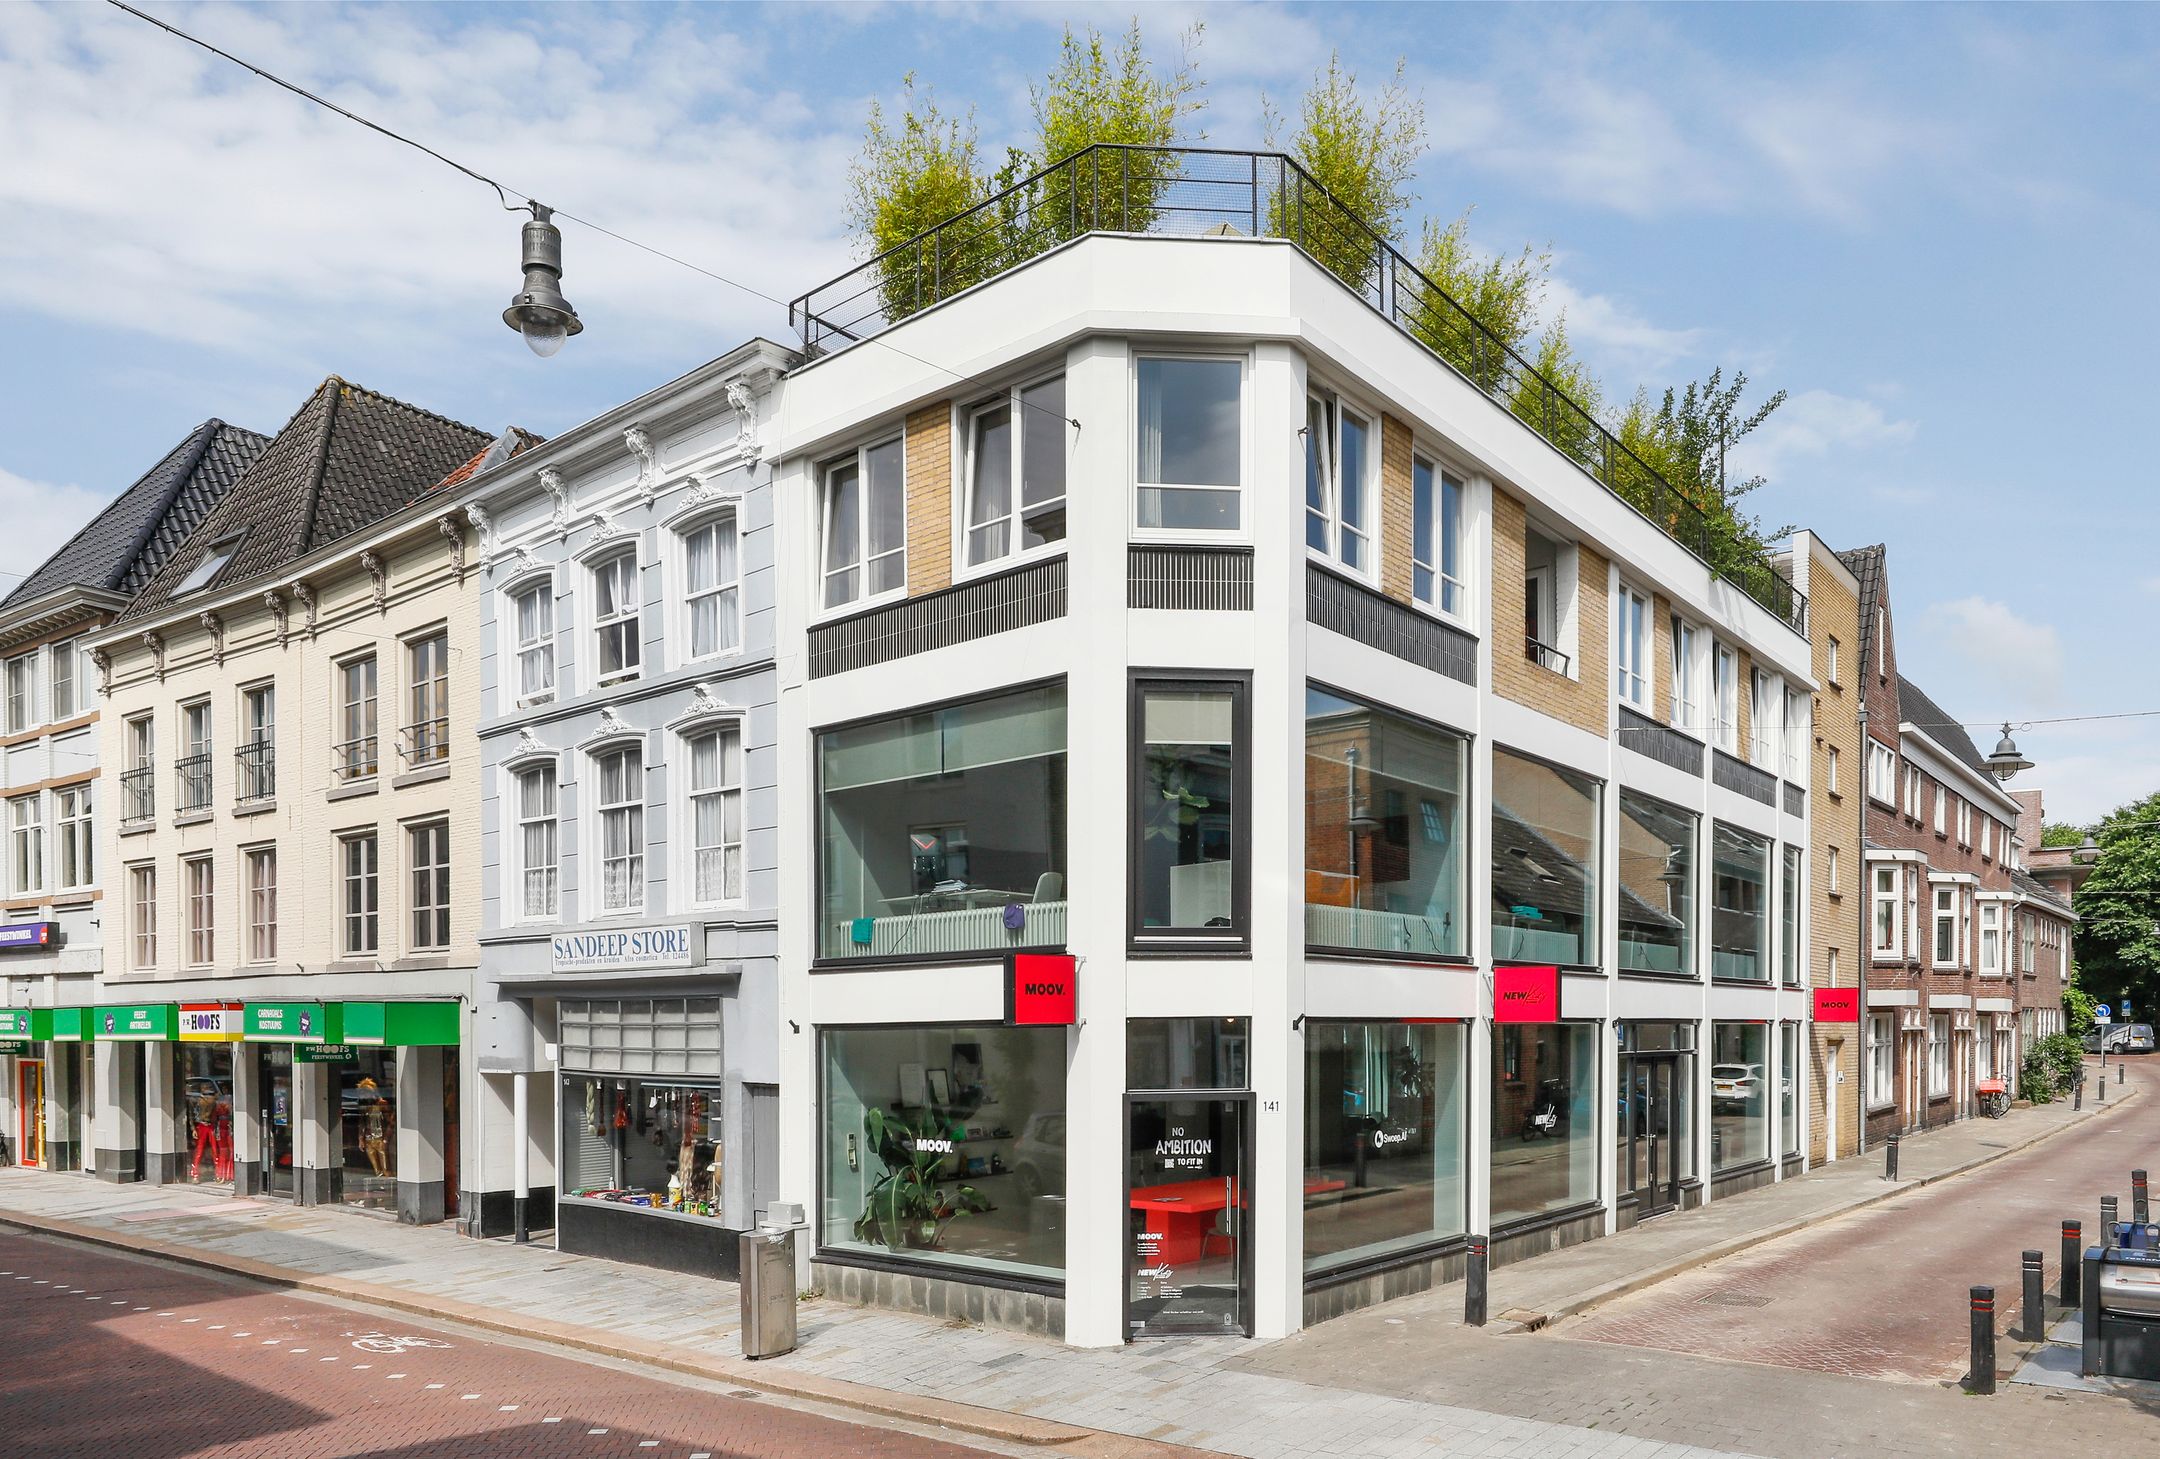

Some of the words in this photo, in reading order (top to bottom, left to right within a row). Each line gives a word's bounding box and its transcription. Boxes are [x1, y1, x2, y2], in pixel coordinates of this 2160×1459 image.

[554, 934, 628, 960] SANDEEP
[632, 929, 689, 955] STORE
[1025, 983, 1066, 995] MOOV.
[191, 1013, 220, 1030] HOOFS
[316, 1045, 350, 1054] HOOFS
[1263, 1101, 1279, 1112] 141
[1171, 1127, 1184, 1136] NO
[916, 1138, 953, 1153] MOOV.
[1155, 1139, 1212, 1155] AMBITION
[1196, 1157, 1203, 1165] IN
